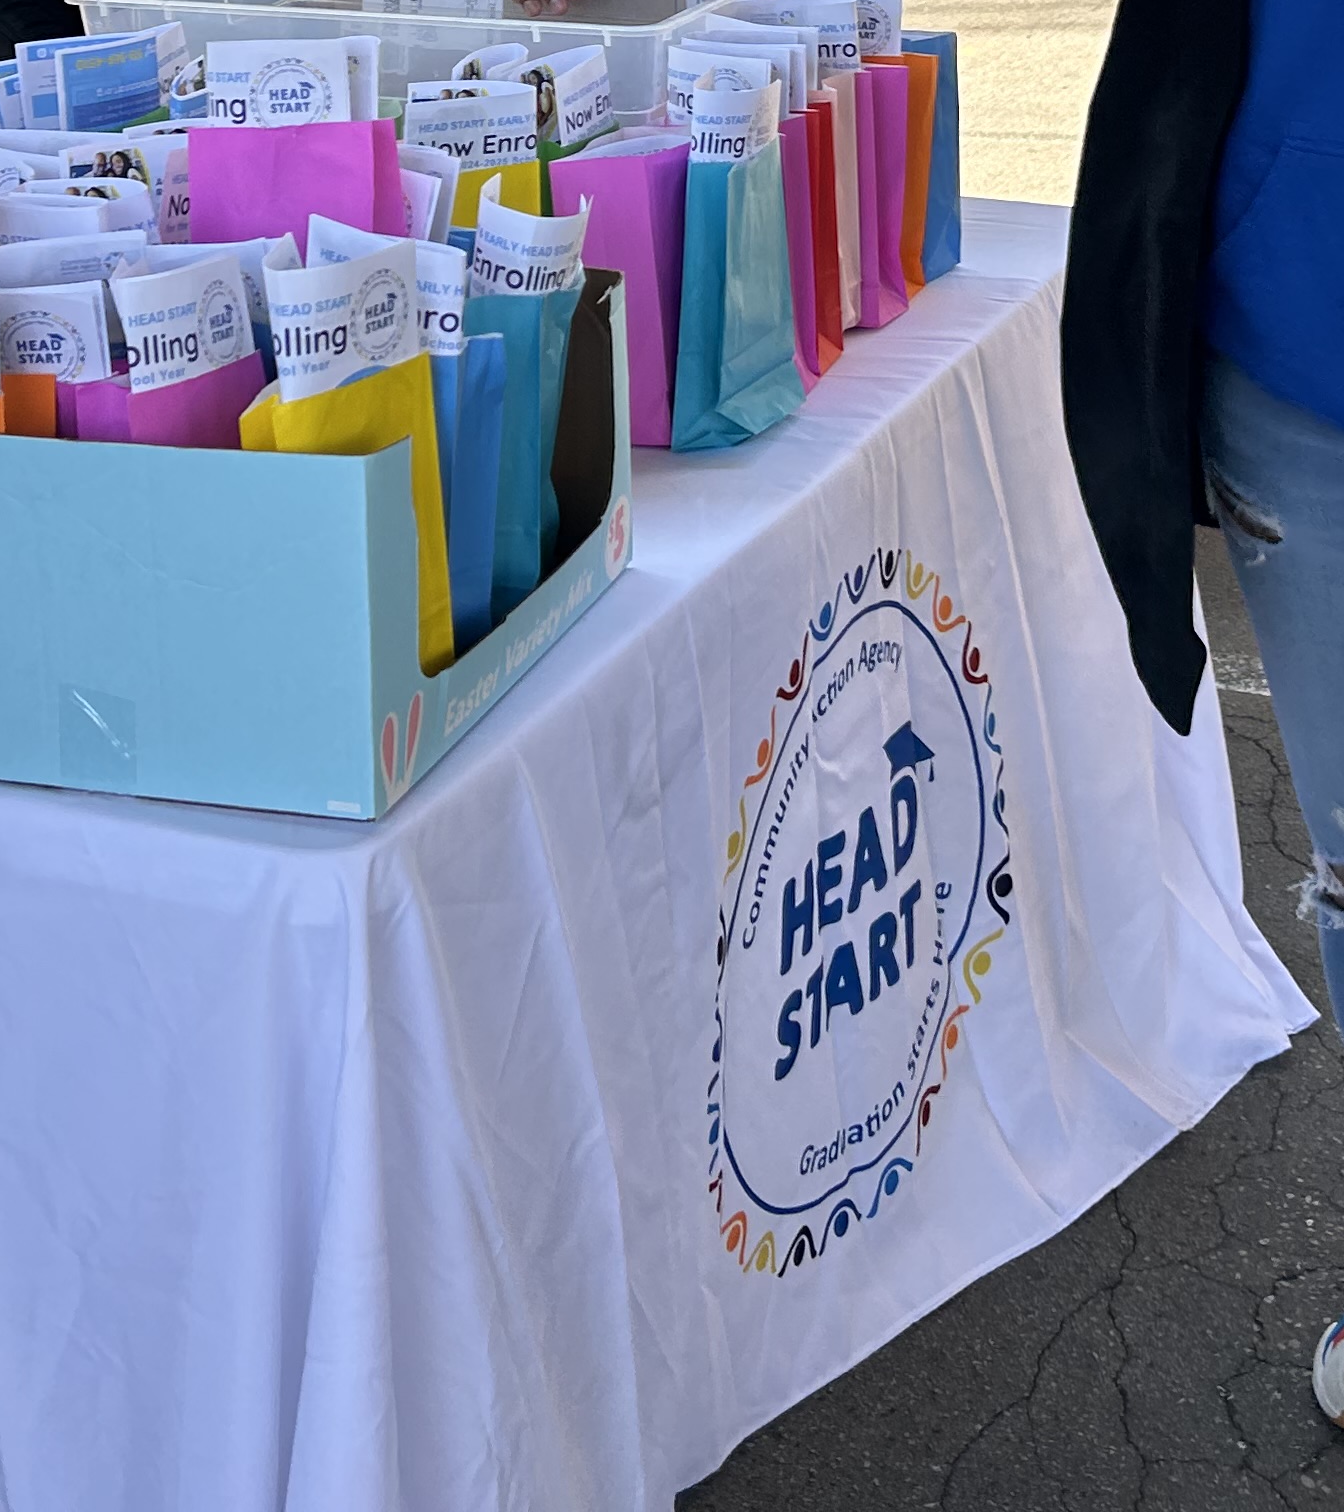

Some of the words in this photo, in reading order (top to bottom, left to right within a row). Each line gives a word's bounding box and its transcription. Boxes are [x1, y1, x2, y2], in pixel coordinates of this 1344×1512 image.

[269, 88, 311, 101] HEAD
[269, 101, 311, 114] START
[418, 122, 449, 134] HEAD
[450, 118, 486, 130] START
[497, 114, 531, 126] EARLY
[565, 105, 593, 135] Now
[316, 292, 353, 314] START
[364, 298, 396, 320] HEAD
[128, 309, 166, 328] HEAD
[167, 301, 198, 320] START
[209, 310, 233, 330] HEAD
[364, 313, 396, 335] START
[211, 325, 235, 344] START
[16, 339, 62, 353] HEAD
[18, 352, 64, 365] START
[304, 359, 331, 375] Year
[158, 367, 186, 382] Year
[443, 661, 501, 737] Easter
[505, 605, 562, 676] Variety
[564, 570, 594, 617] Mix
[780, 774, 918, 977] HEAD
[774, 878, 922, 1082] START
